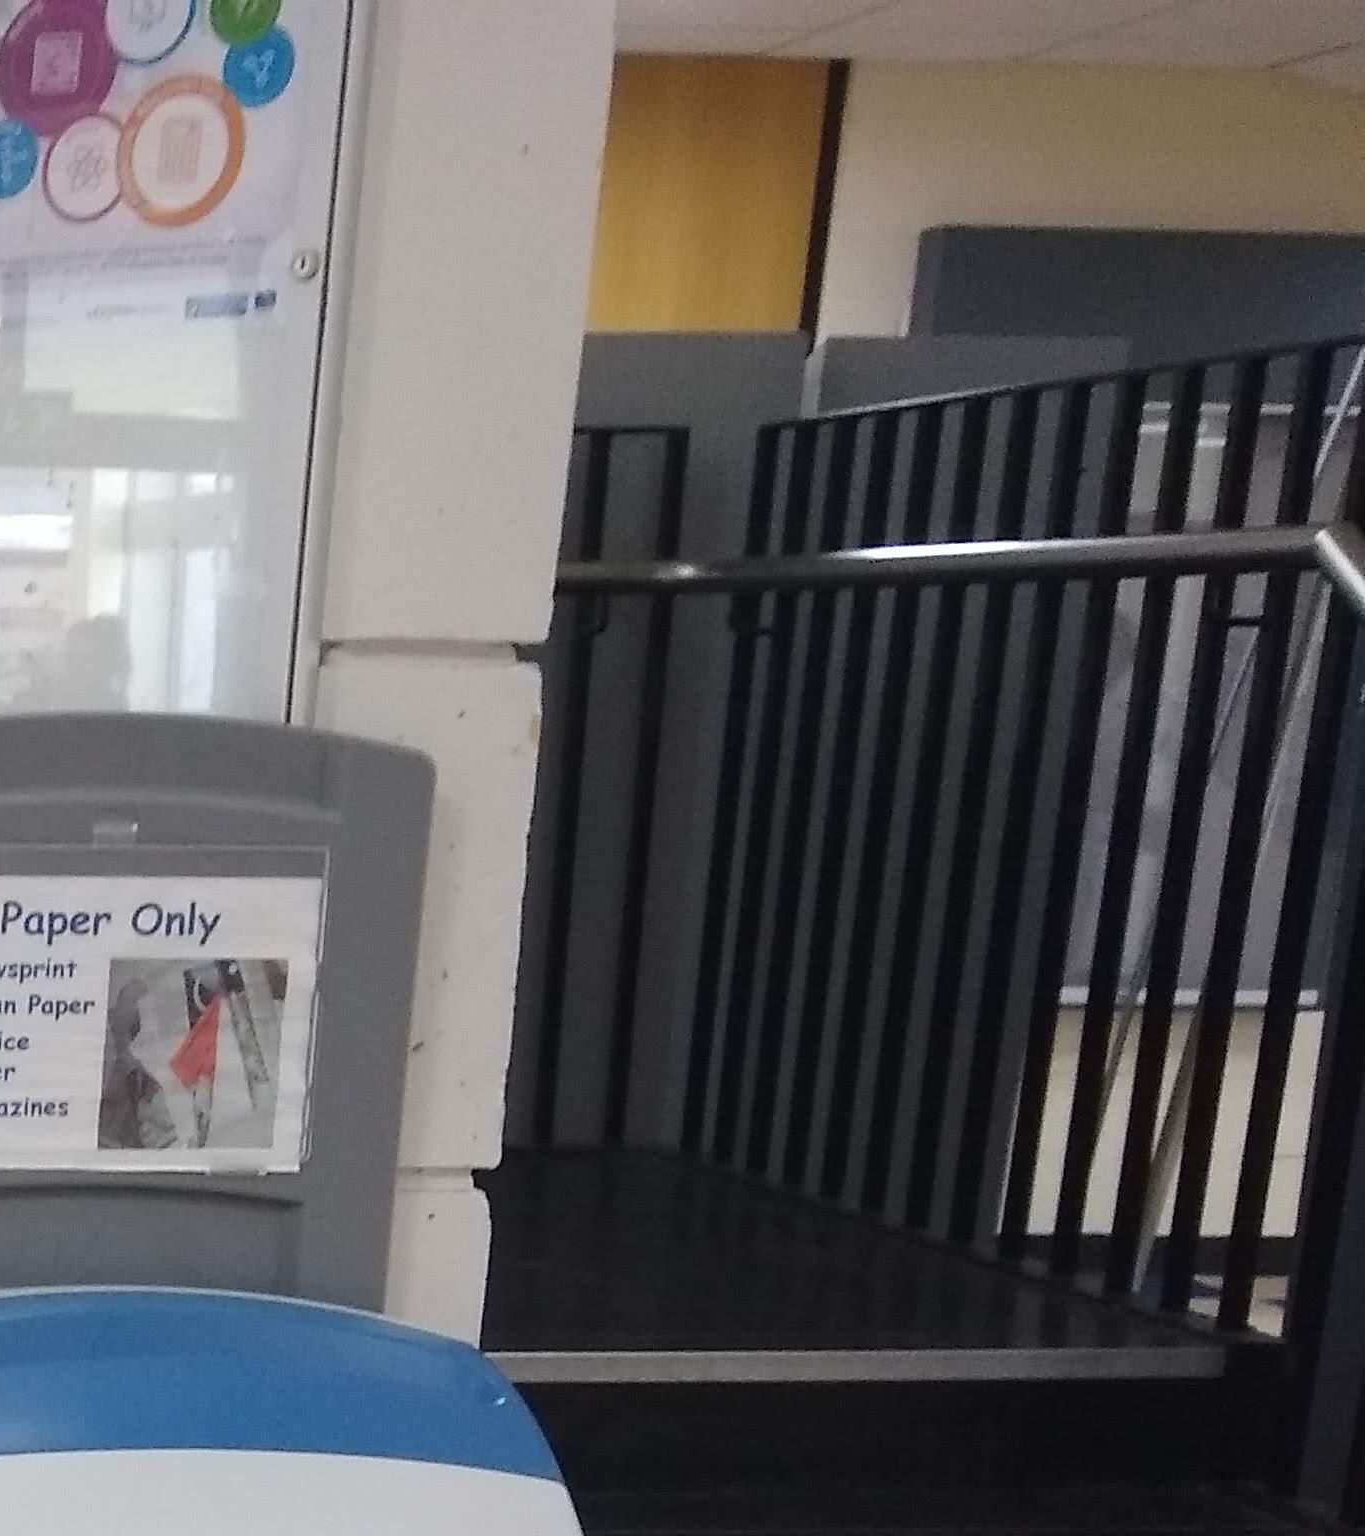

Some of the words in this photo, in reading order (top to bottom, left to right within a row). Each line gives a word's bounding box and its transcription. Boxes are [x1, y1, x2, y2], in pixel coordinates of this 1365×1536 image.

[0, 901, 111, 945] Paper
[130, 902, 222, 945] Only
[28, 997, 96, 1021] Paper
